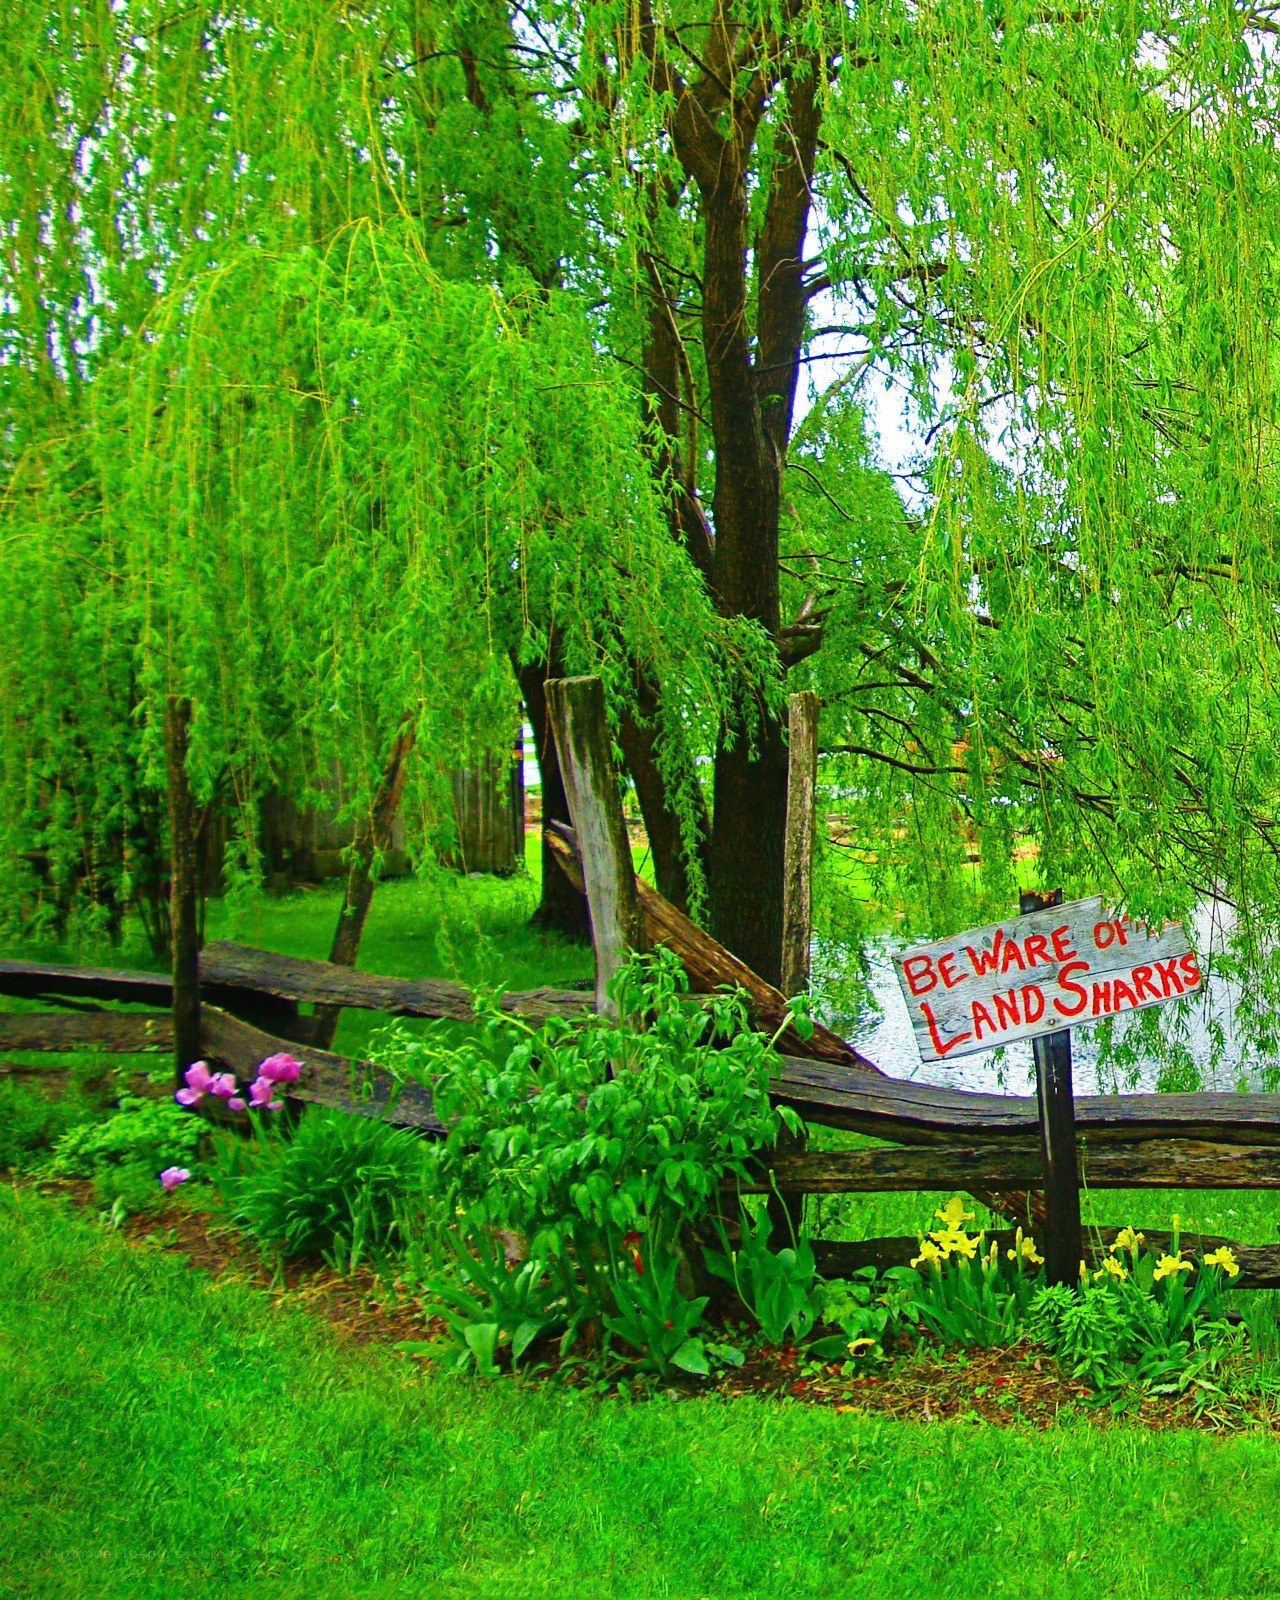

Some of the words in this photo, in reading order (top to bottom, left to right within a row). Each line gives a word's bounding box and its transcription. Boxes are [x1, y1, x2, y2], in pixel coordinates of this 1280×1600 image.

[902, 924, 1078, 997] BEWARE
[919, 984, 1046, 1056] LAND
[1053, 952, 1202, 1018] SHARKS
